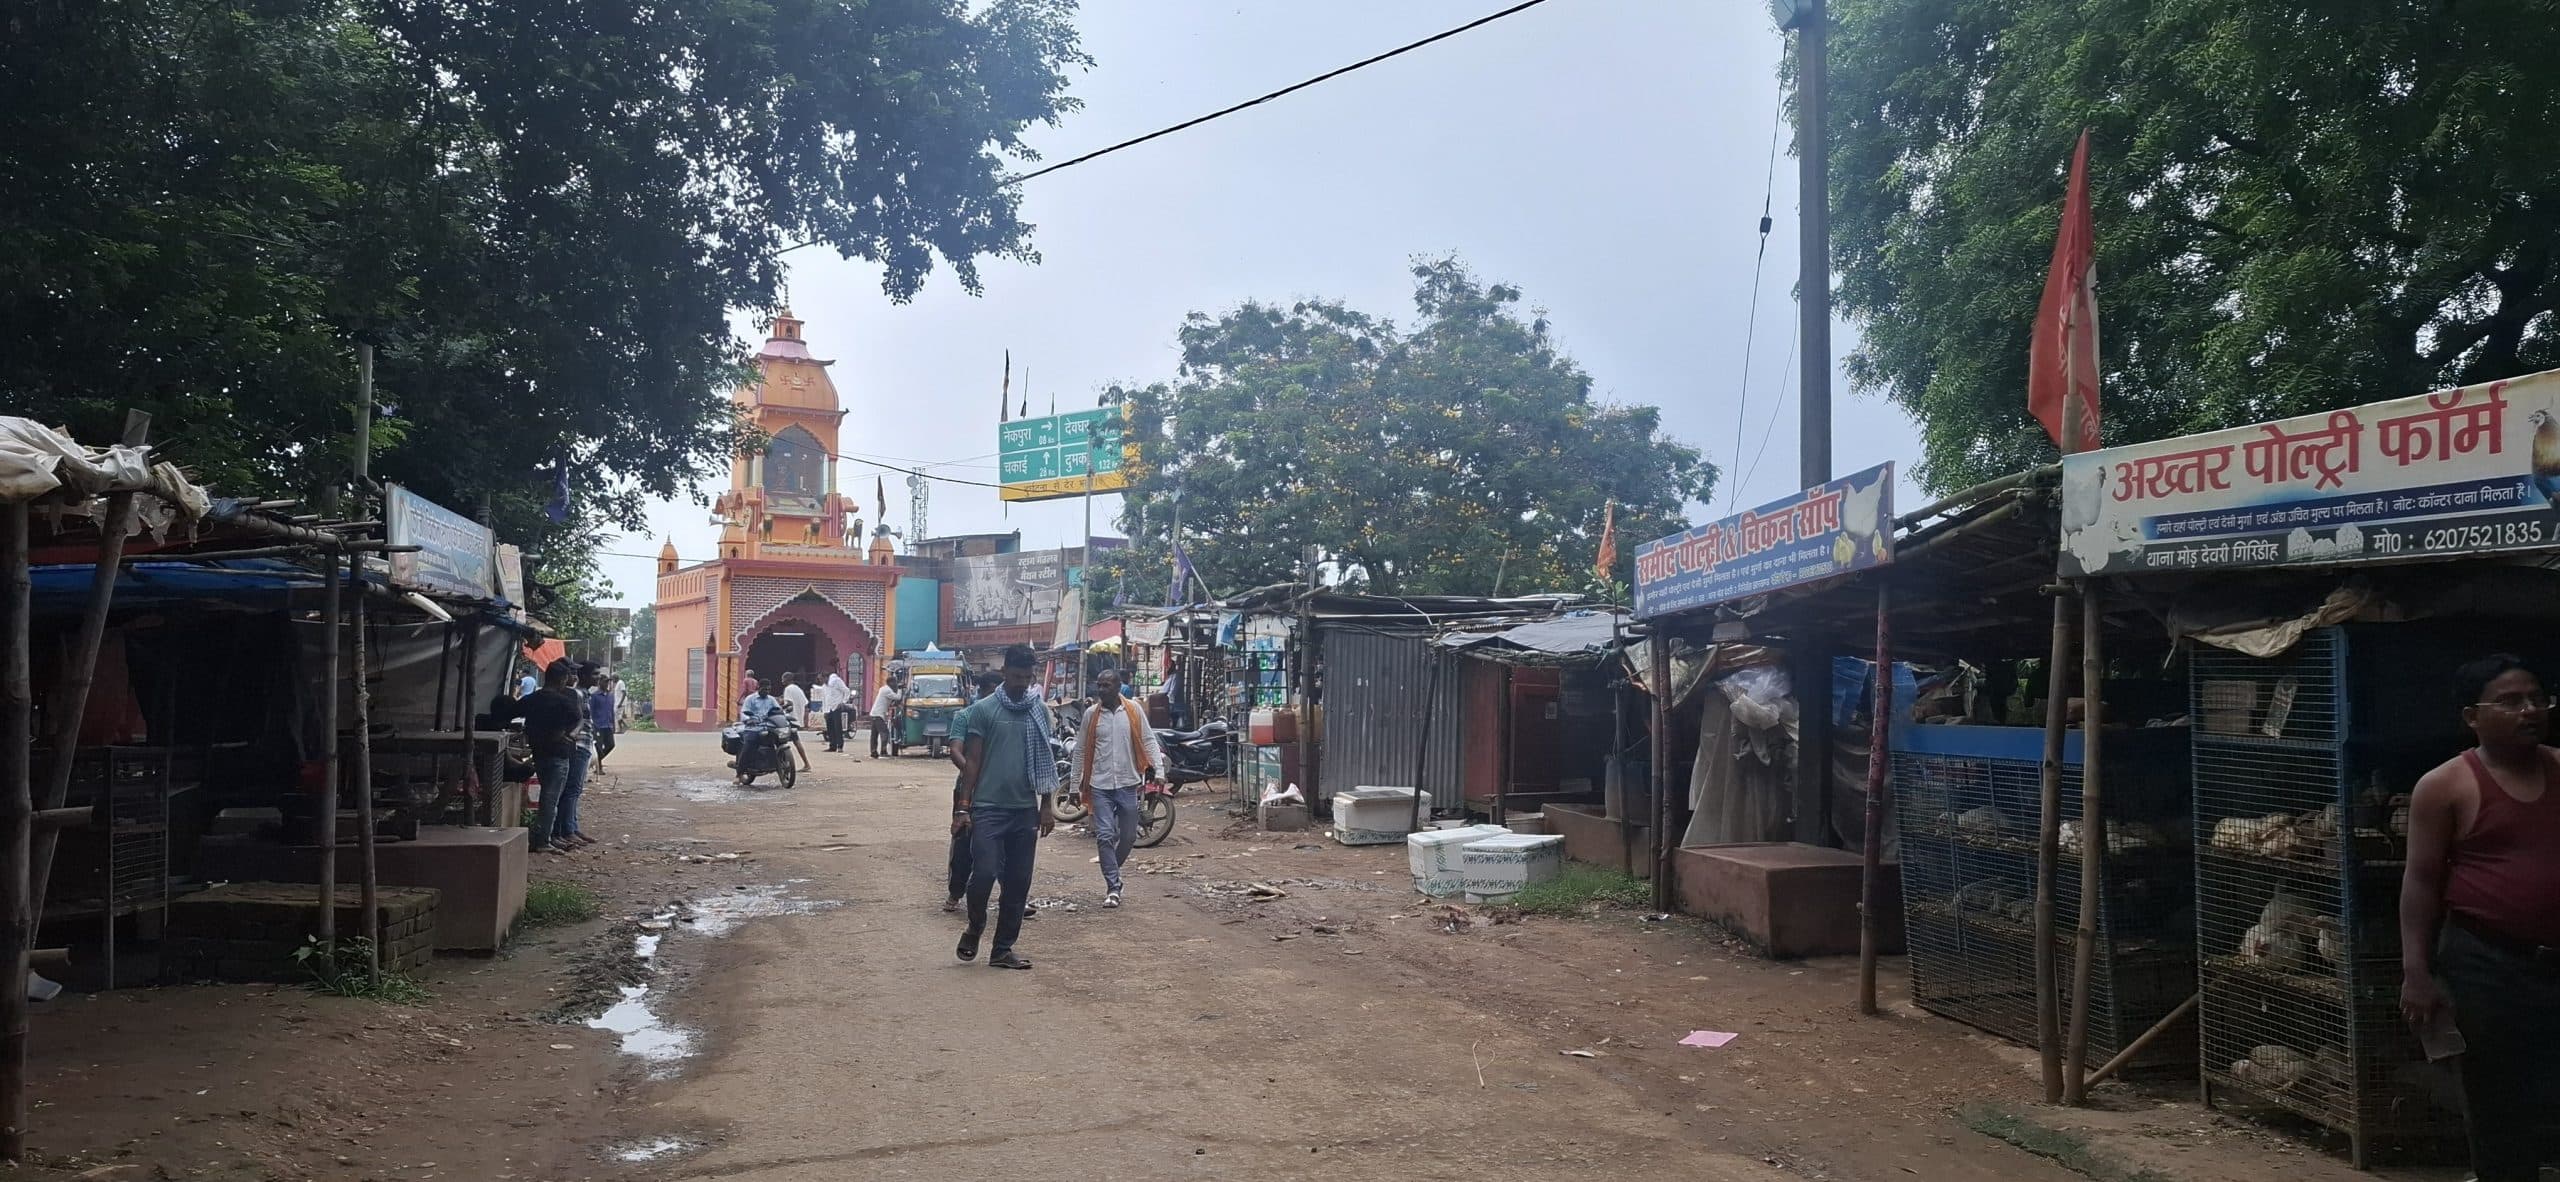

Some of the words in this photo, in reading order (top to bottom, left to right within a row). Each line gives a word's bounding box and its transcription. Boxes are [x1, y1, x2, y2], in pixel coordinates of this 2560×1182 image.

[1003, 426, 1031, 447] नेकपुरा
[1064, 417, 1089, 435] देवघर
[2112, 445, 2235, 501] अख्तर
[2243, 410, 2364, 489] पोल्ट्री
[2377, 381, 2508, 466] फॉर्म
[1003, 455, 1028, 474] चकाई
[1064, 452, 1089, 473] दुमक
[2208, 516, 2220, 529] एवं
[2221, 514, 2236, 528] देसी
[2256, 512, 2268, 525] एवं
[2271, 509, 2286, 524] अंडा
[2288, 506, 2308, 522] उचित
[2332, 506, 2345, 517] पर
[2347, 501, 2374, 516] मिलता
[2454, 490, 2477, 505] दाना
[2480, 486, 2513, 502] मिलता
[1677, 523, 1722, 574] पोल्ट्री
[1724, 523, 1738, 561] &
[1739, 511, 1794, 556] चिकन
[1798, 485, 1842, 539] सॉप
[2424, 521, 2542, 550] 6207521835
[2147, 550, 2174, 567] थाना
[2177, 546, 2197, 568] मोड़
[2201, 542, 2229, 563] देवरी
[2232, 539, 2279, 562] गिरिडीह
